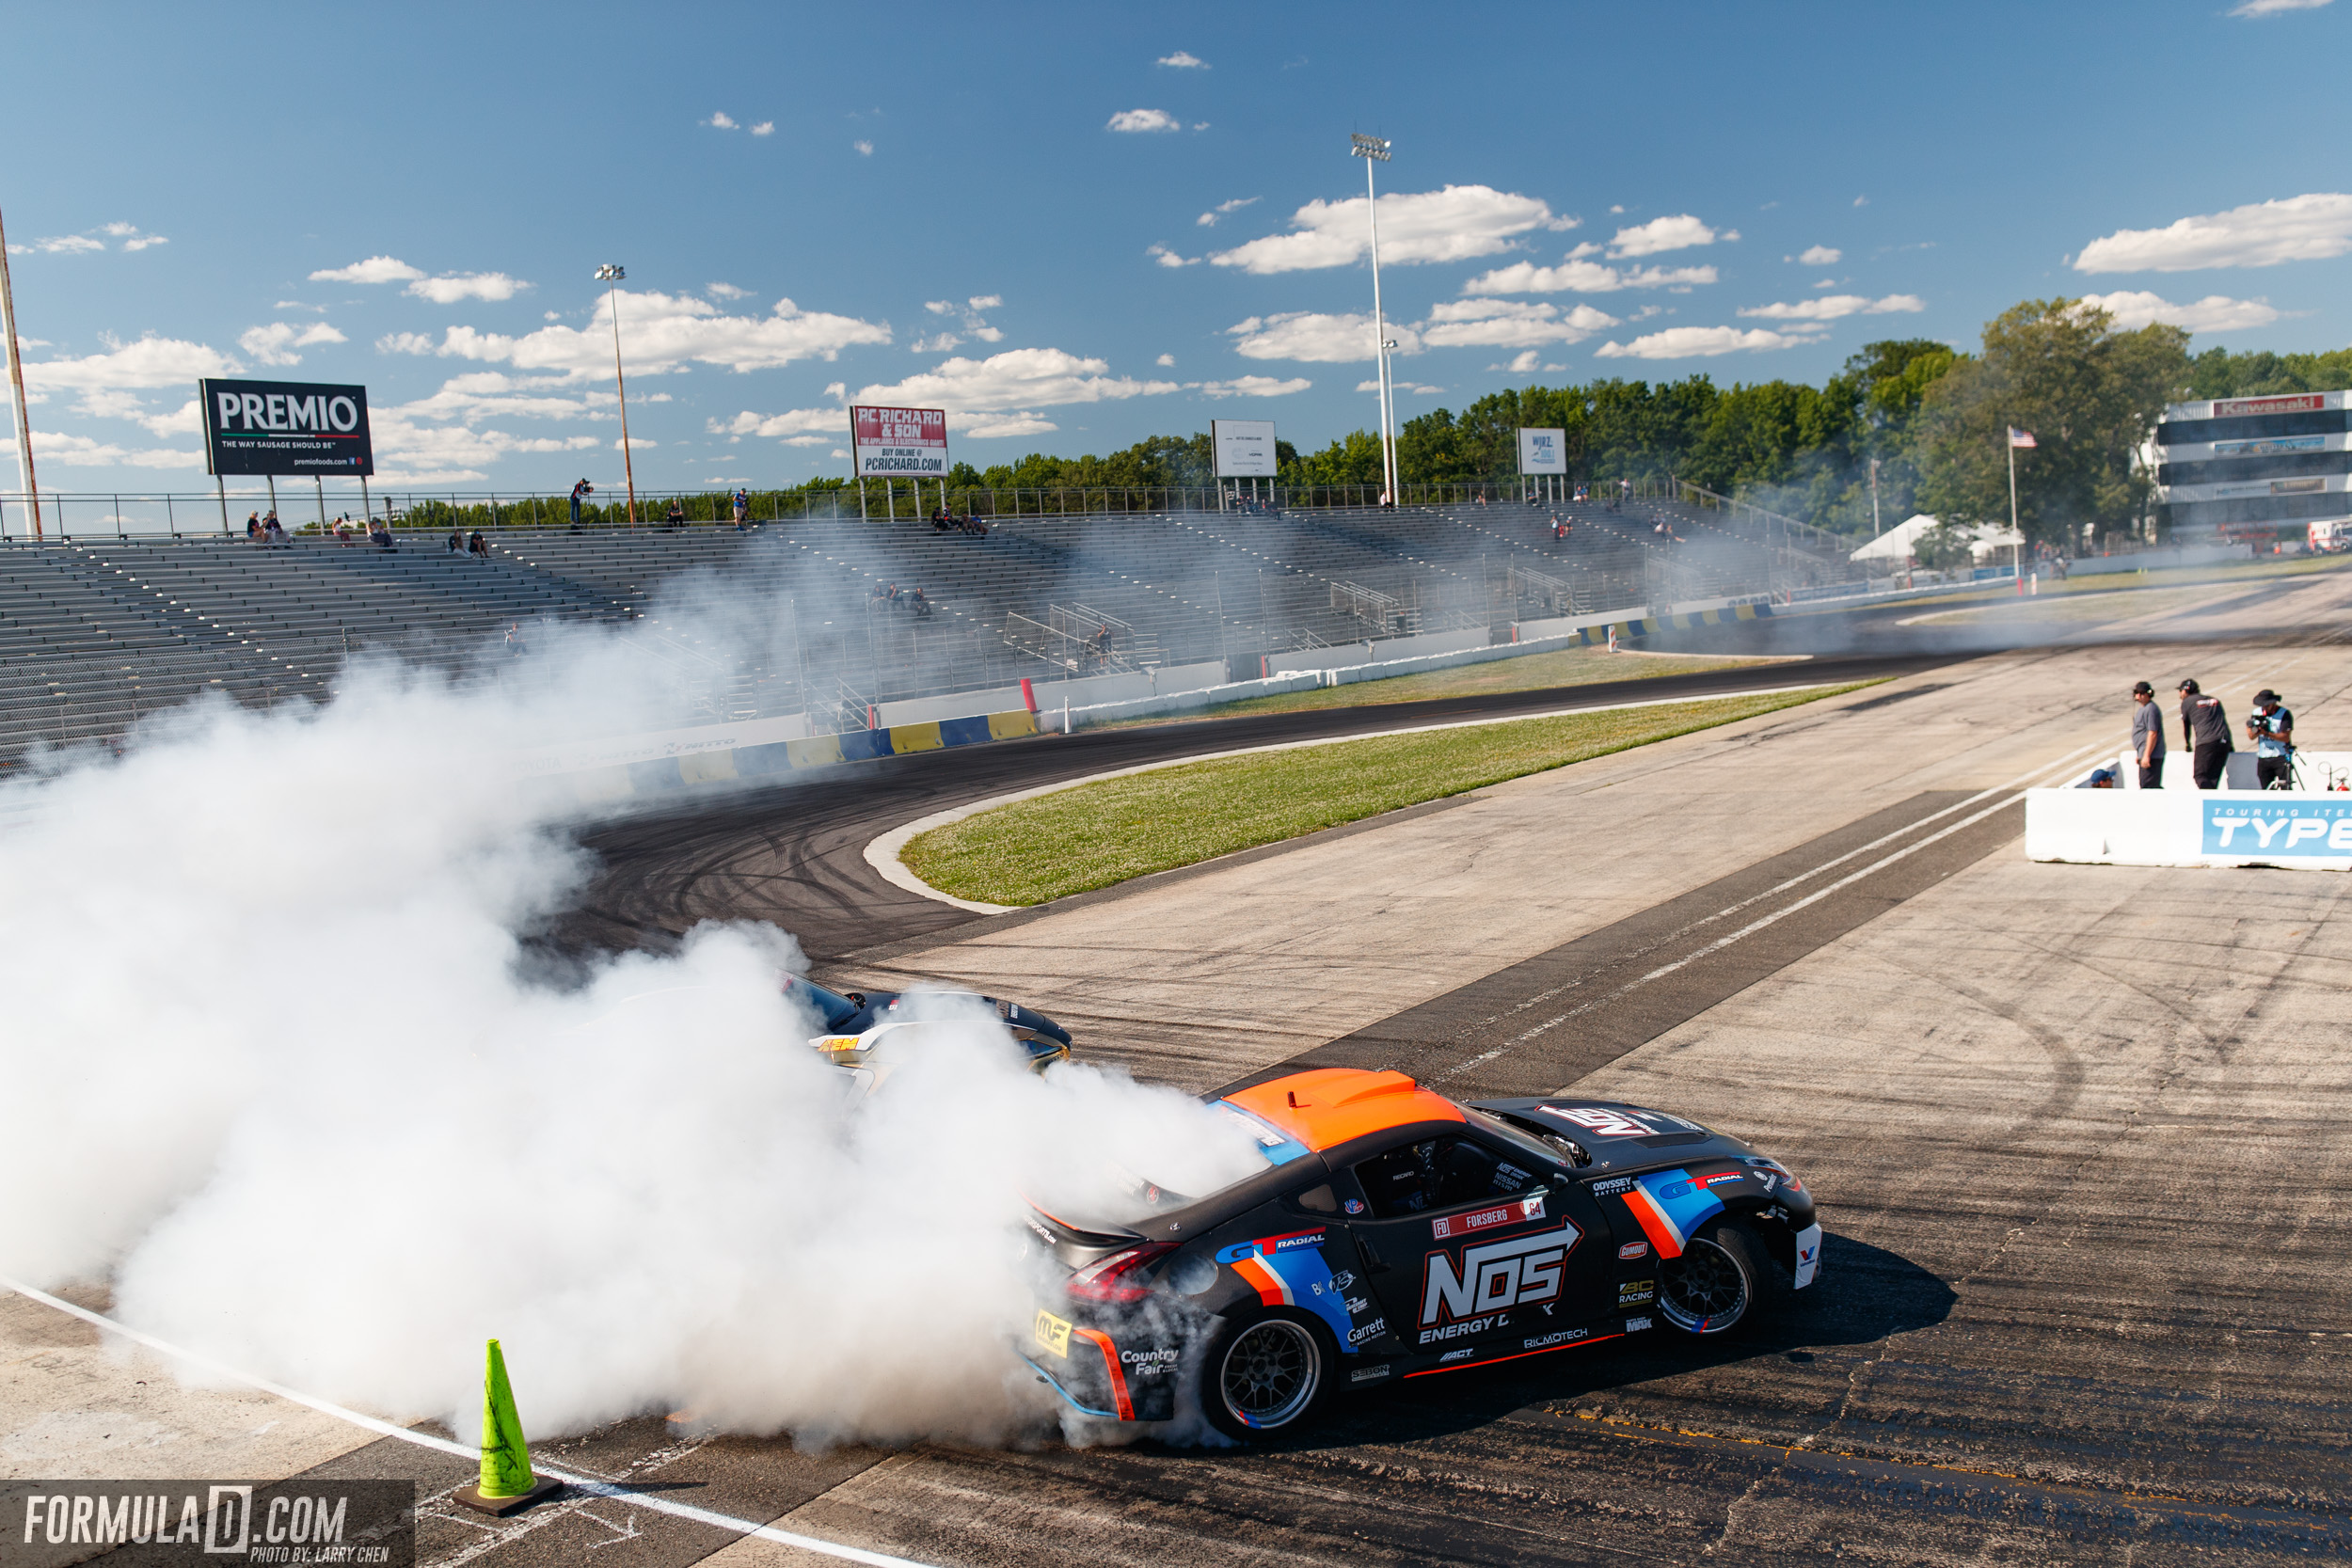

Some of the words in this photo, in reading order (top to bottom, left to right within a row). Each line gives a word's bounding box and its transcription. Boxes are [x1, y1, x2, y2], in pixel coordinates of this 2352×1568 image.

[217, 392, 358, 432] PREMIO
[2221, 397, 2314, 414] Kawasaki
[879, 408, 943, 424] RICHARD
[882, 423, 893, 437] &
[894, 424, 921, 437] SON
[292, 441, 322, 450] SHOULD
[1533, 436, 1553, 451] WJRZ
[882, 448, 894, 456] BUY
[895, 449, 915, 457] ONLINE
[916, 449, 922, 457] @
[294, 457, 348, 466] premiofoods.com
[866, 457, 942, 471] PCRICHARD.COM
[511, 756, 562, 773] TOYOTA
[2214, 807, 2299, 816] TOURING
[2313, 808, 2352, 816] ITE
[817, 1037, 860, 1053] AEM
[1393, 1170, 1415, 1181] RECARO
[1496, 1162, 1516, 1174] NOS
[1494, 1172, 1522, 1190] NISSAN
[1593, 1177, 1631, 1192] ODYSSEY
[1706, 1174, 1743, 1184] RADIAL
[1595, 1185, 1631, 1197] BATTERY
[1344, 1198, 1358, 1213] VP
[1436, 1220, 1448, 1235] FD
[1466, 1209, 1508, 1228] FORSBERG
[1529, 1201, 1541, 1216] 64
[1278, 1234, 1325, 1248] RADIAL
[1621, 1244, 1645, 1257] GUMOUT
[1422, 1221, 1580, 1324] NOS
[1619, 1291, 1653, 1304] RACING
[1347, 1317, 1385, 1342] Garrett
[1419, 1316, 1495, 1344] ENERGY
[1626, 1319, 1653, 1333] MAX
[1524, 1327, 1588, 1349] RICMOTECH
[1120, 1348, 1179, 1363] Country
[1136, 1360, 1164, 1375] Fair
[1352, 1365, 1390, 1379] SEBON
